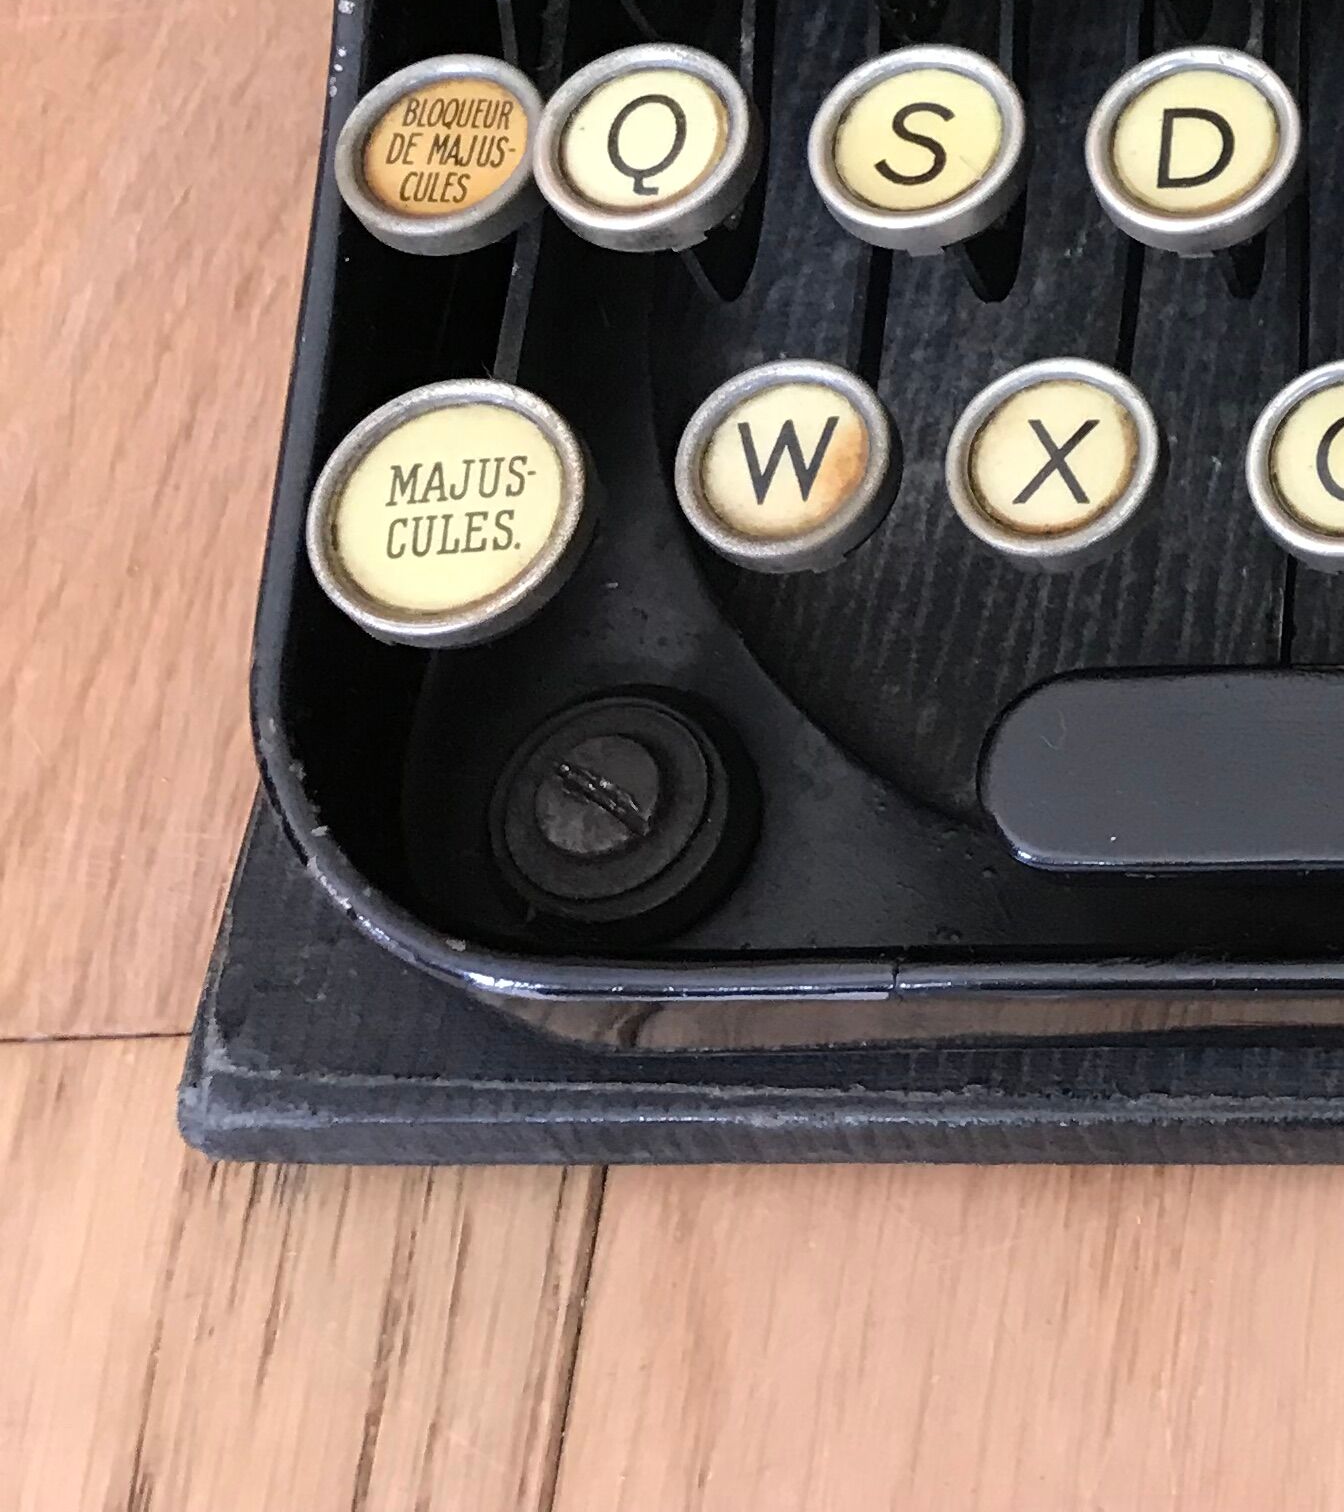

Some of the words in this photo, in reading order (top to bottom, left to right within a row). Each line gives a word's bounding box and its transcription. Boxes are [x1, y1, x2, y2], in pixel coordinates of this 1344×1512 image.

[402, 98, 513, 130] BLOQUEUR
[608, 95, 687, 195] Q
[875, 103, 954, 185] S
[386, 133, 423, 165] DE
[427, 133, 516, 168] MAJUS-
[1157, 108, 1234, 188] D
[400, 172, 470, 203] CULES
[385, 455, 537, 507] MAJUS-
[737, 415, 841, 506] W
[1013, 420, 1101, 505] X
[386, 509, 522, 559] CULES.
